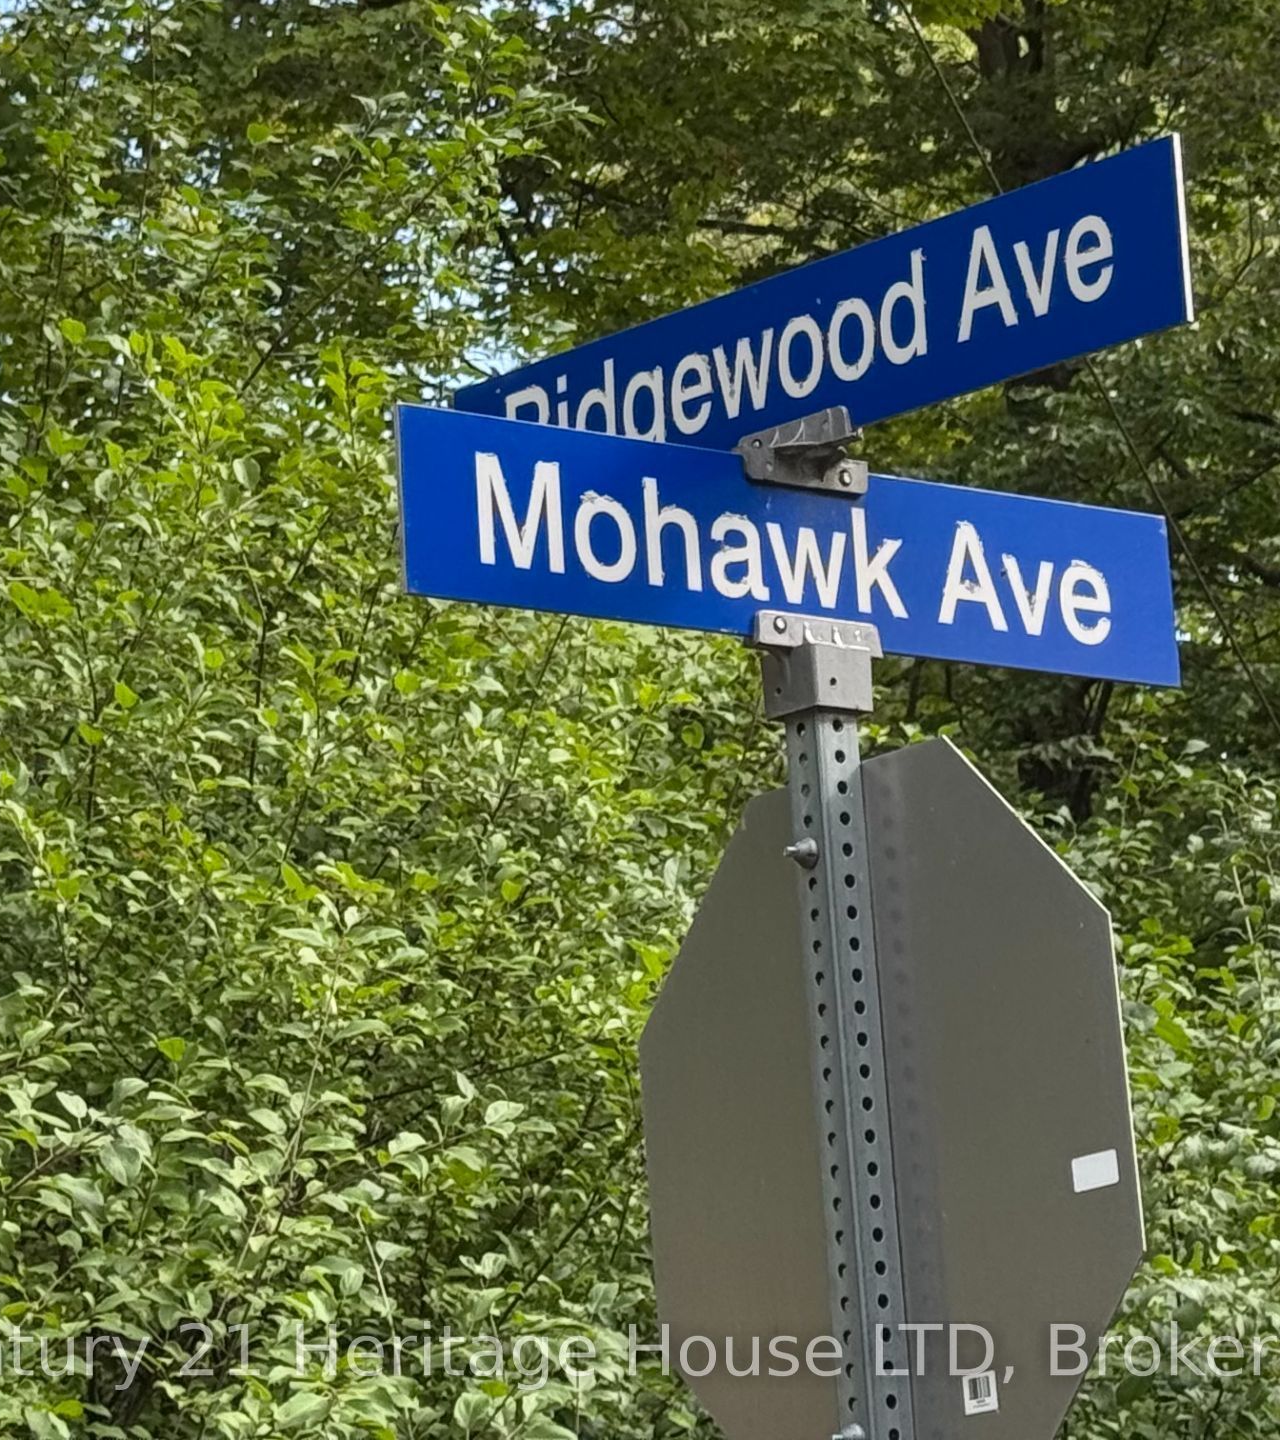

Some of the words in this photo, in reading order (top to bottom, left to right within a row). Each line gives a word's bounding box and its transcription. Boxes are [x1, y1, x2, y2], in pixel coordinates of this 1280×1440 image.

[958, 214, 1114, 343] Ave
[475, 451, 908, 620] Mohawk
[938, 520, 1112, 647] Ave
